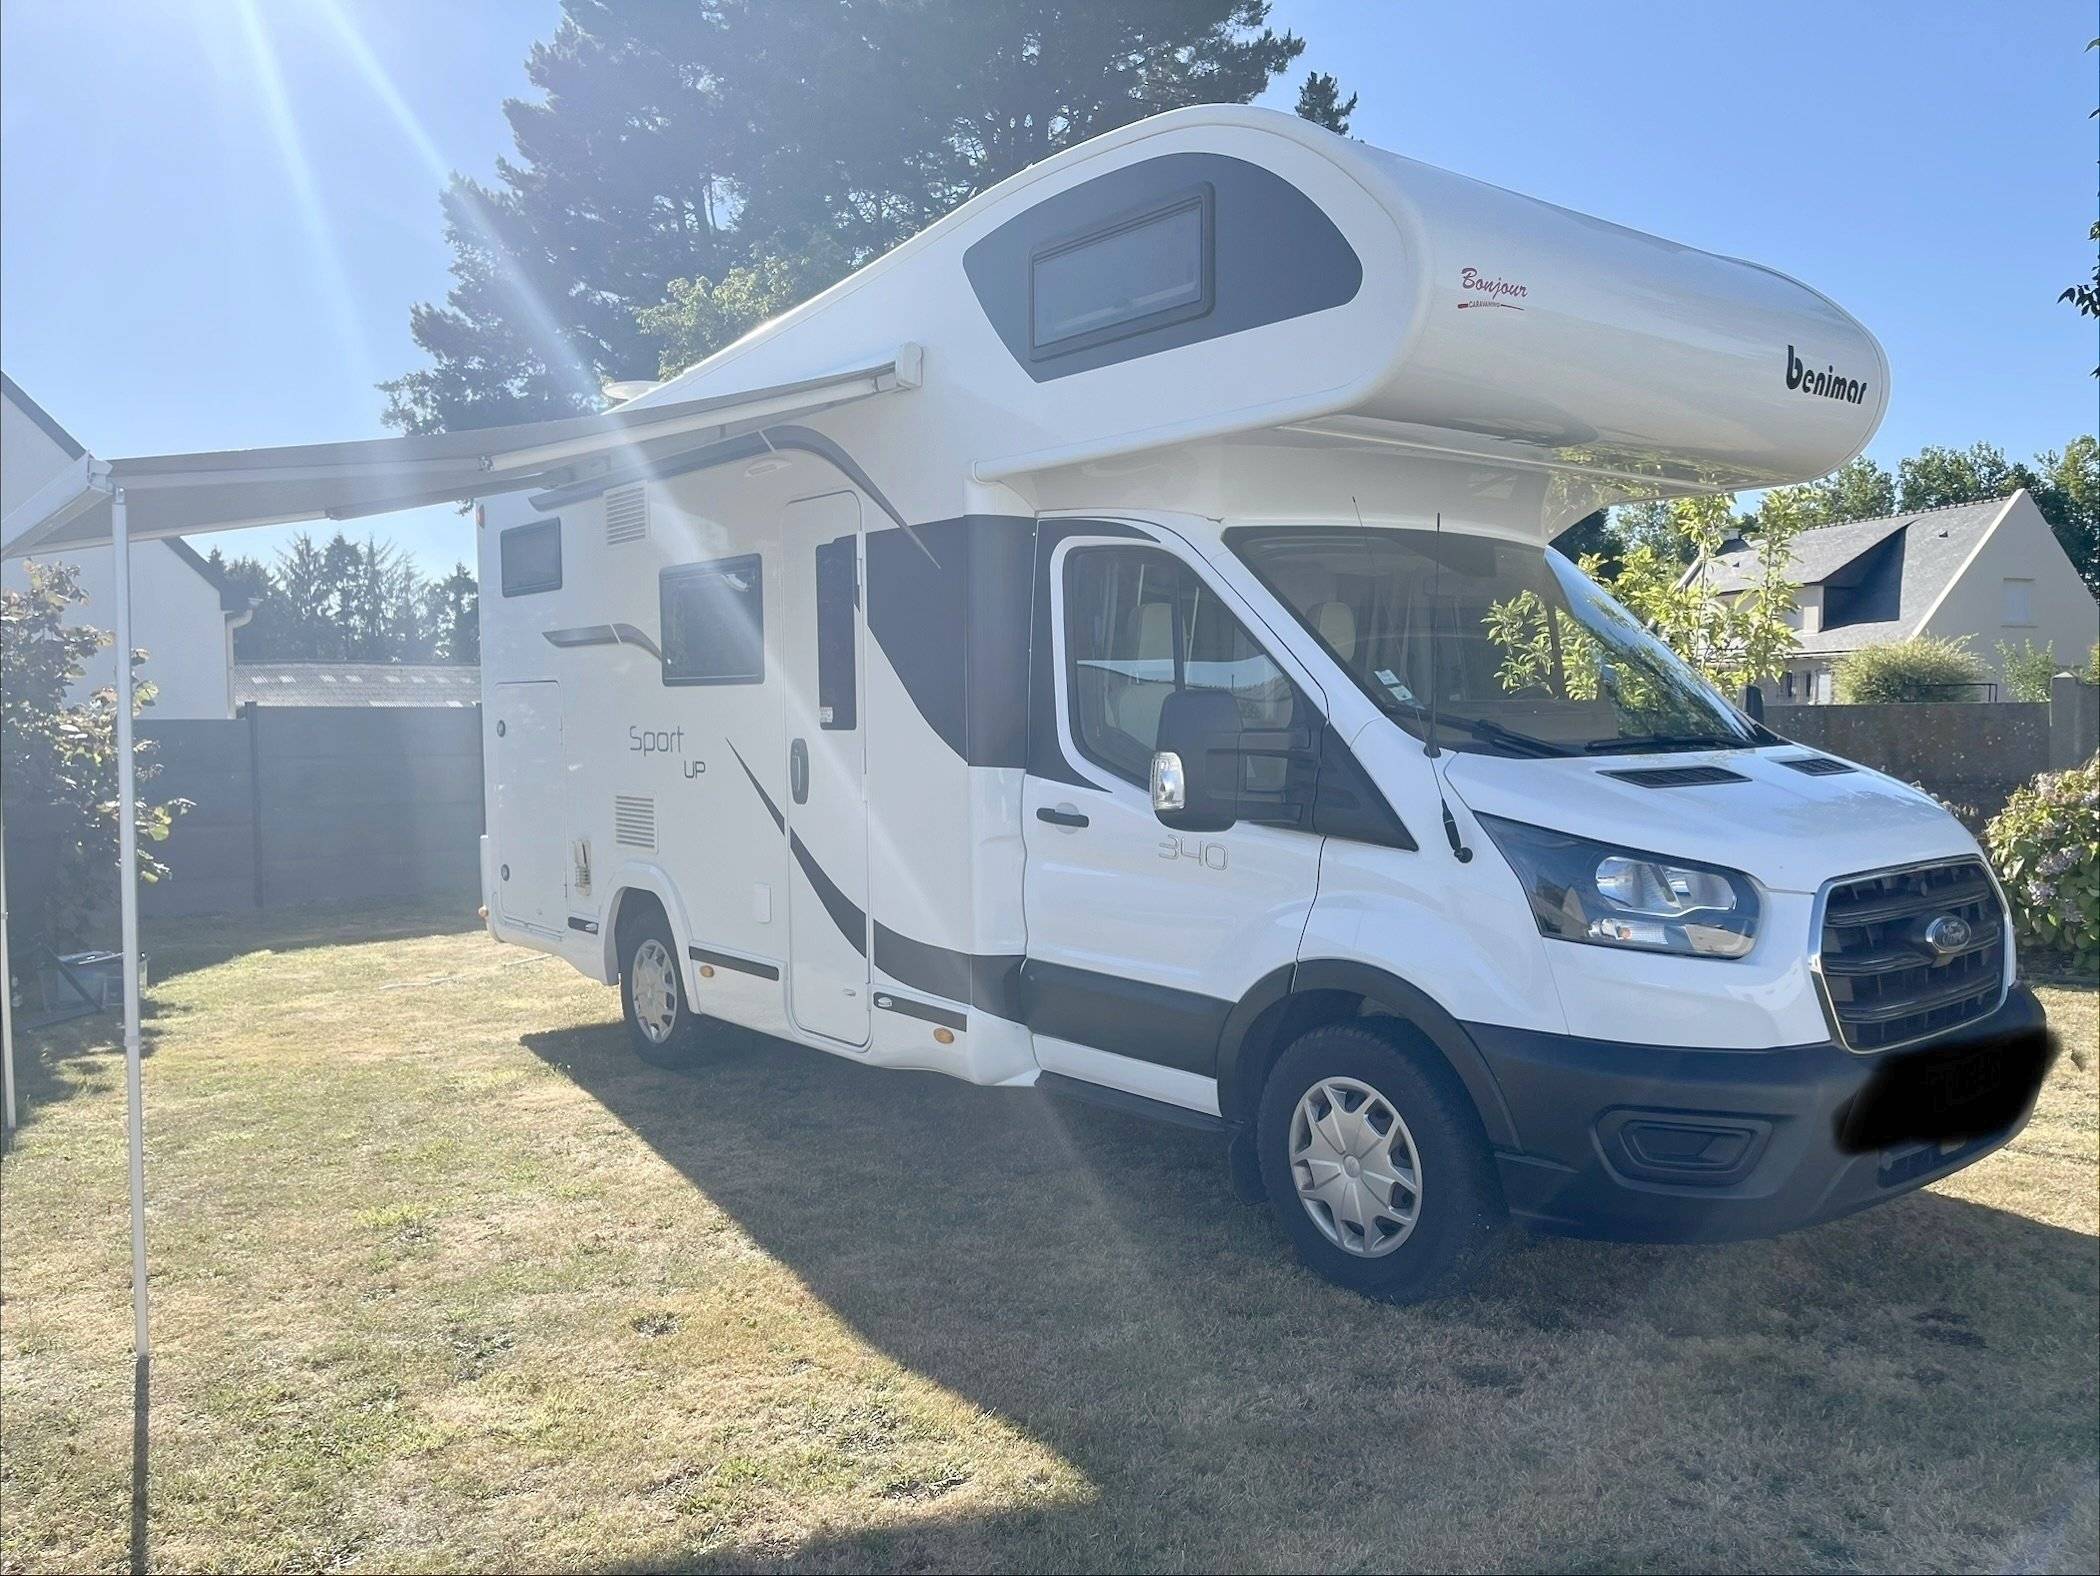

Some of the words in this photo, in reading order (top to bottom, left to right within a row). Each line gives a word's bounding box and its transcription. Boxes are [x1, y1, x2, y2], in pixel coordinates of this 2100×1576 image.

[1461, 267, 1528, 300] Bonjour
[1786, 344, 1867, 404] benimar
[629, 725, 685, 757] Sport
[683, 760, 706, 779] UP
[1158, 834, 1229, 871] 340
